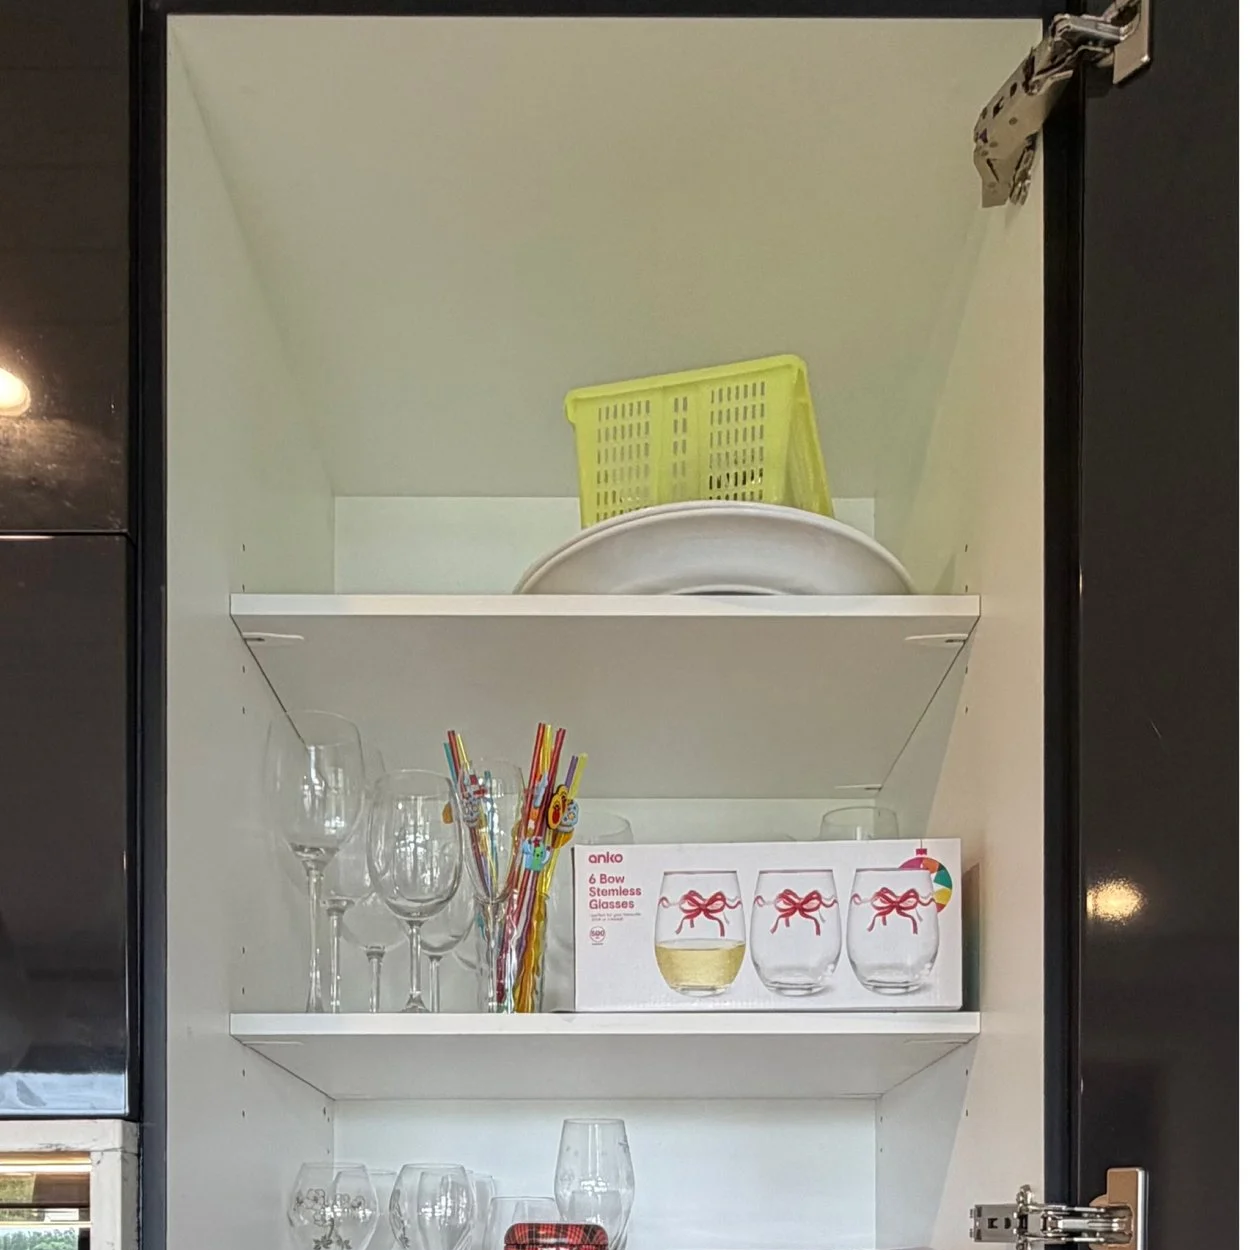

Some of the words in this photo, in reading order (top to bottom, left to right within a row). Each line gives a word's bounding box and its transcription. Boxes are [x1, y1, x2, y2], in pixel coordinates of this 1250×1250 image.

[588, 852, 623, 863] anko
[589, 873, 596, 884] 6
[600, 873, 625, 884] Bow
[589, 885, 642, 897] Stemless
[589, 898, 635, 909] Glasses
